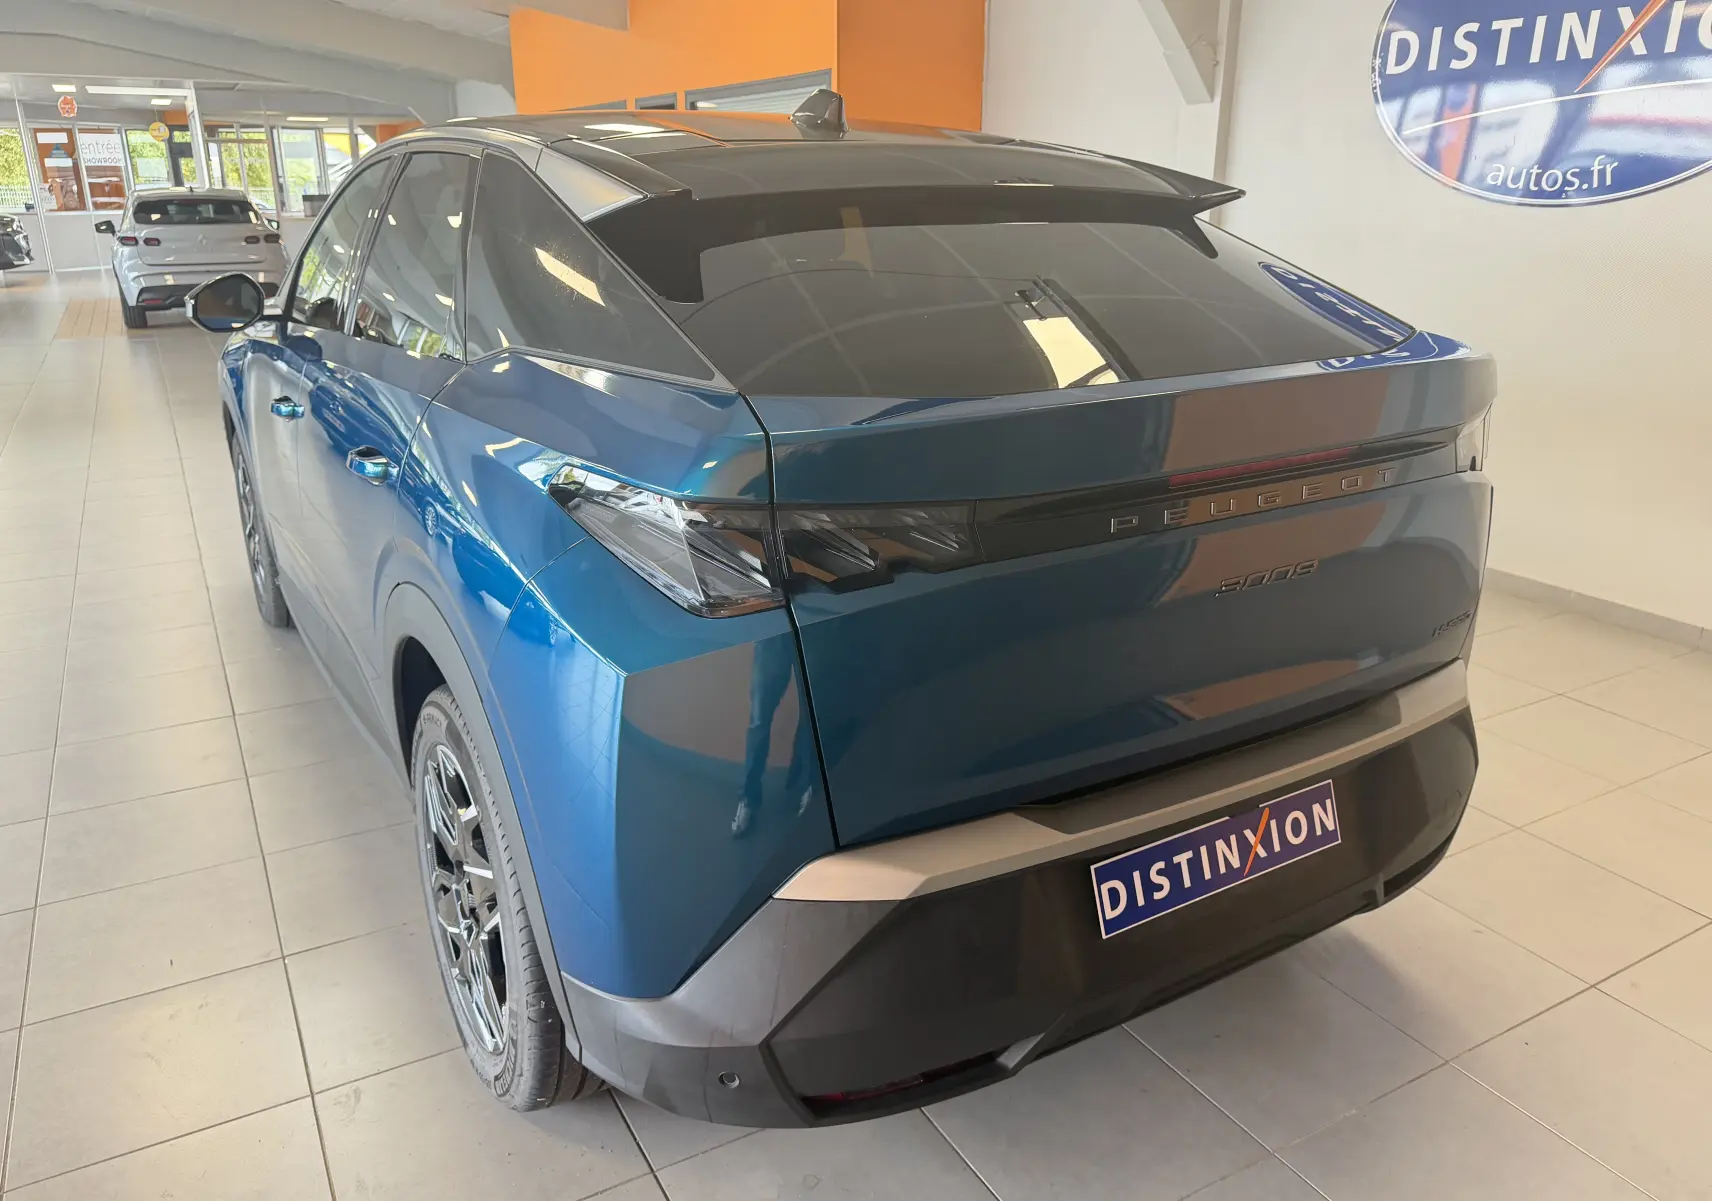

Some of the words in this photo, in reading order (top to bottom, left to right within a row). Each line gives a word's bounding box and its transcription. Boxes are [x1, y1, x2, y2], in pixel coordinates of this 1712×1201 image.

[80, 140, 120, 155] entrée
[1486, 154, 1619, 192] autos.fr
[1110, 467, 1395, 533] PEUGEOT
[1100, 798, 1337, 921] DISTINXION
